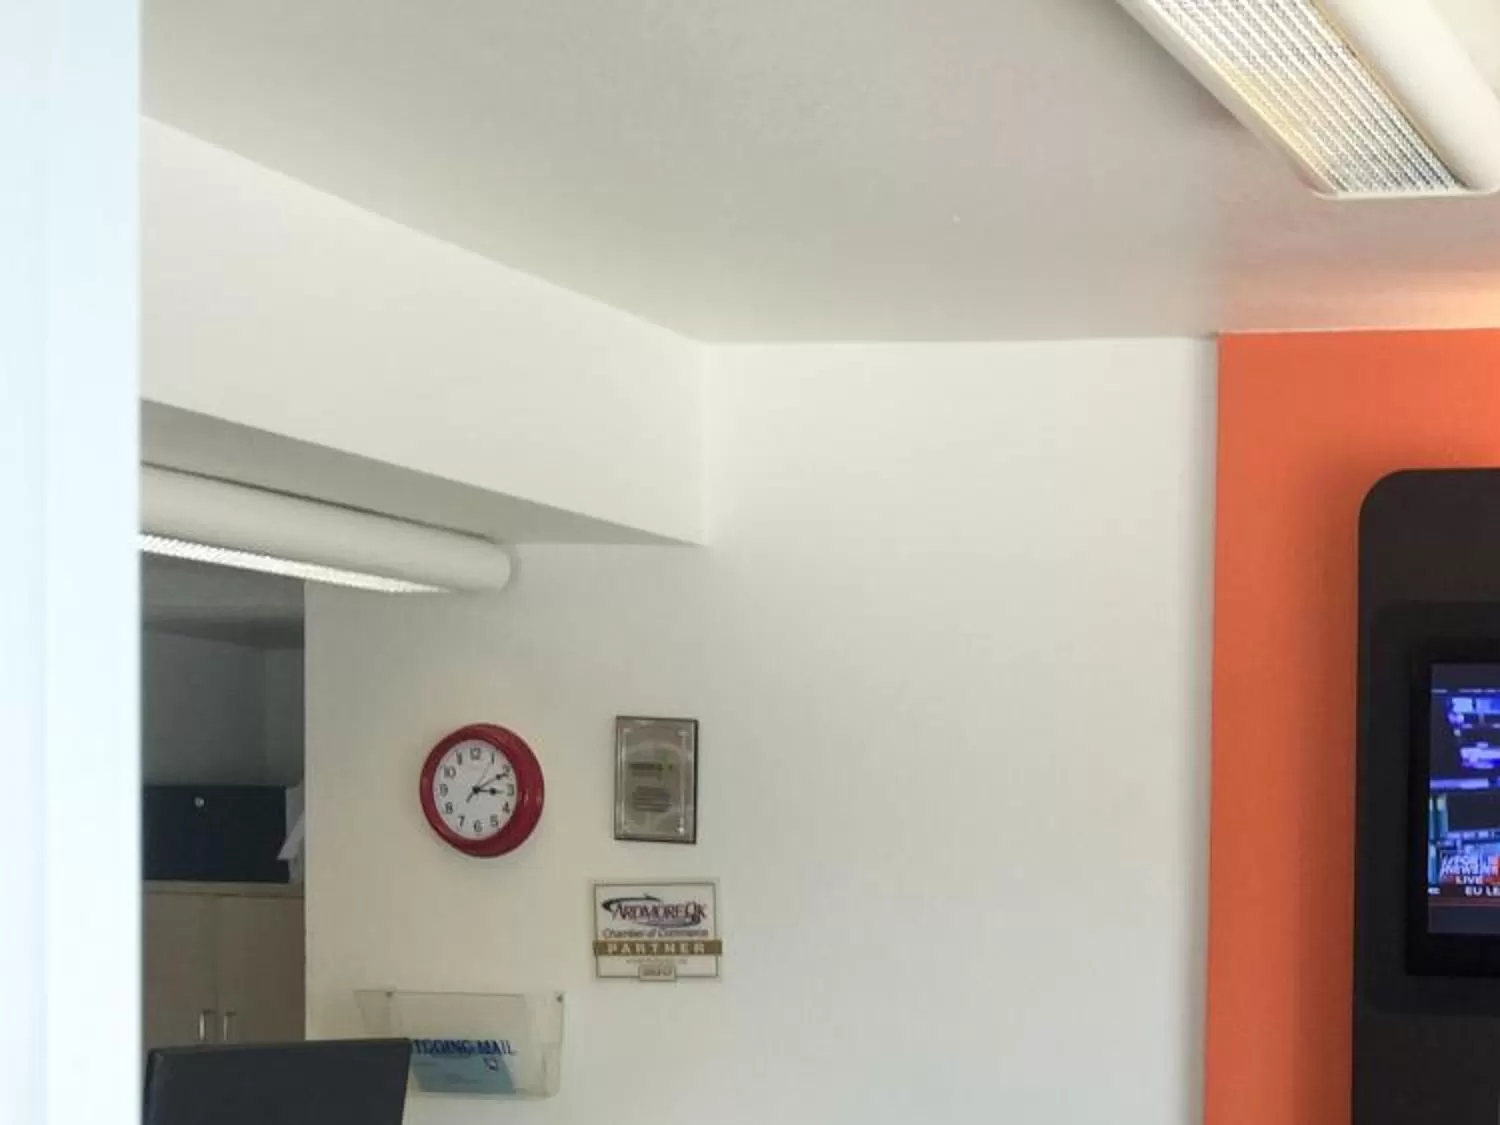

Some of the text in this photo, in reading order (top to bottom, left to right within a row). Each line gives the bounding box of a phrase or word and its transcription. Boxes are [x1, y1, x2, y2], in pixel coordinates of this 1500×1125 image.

[469, 747, 481, 760] 12
[490, 752, 495, 764] 1
[443, 766, 456, 779] 10
[439, 783, 448, 798] 9
[506, 783, 515, 797] 3
[444, 801, 453, 815] 8
[502, 801, 511, 814] 4
[458, 815, 465, 827] 7
[473, 819, 482, 833] 6
[489, 814, 499, 828] 5
[1456, 876, 1483, 885] LIVE
[1465, 887, 1483, 897] EU
[607, 943, 705, 954] PARTNER
